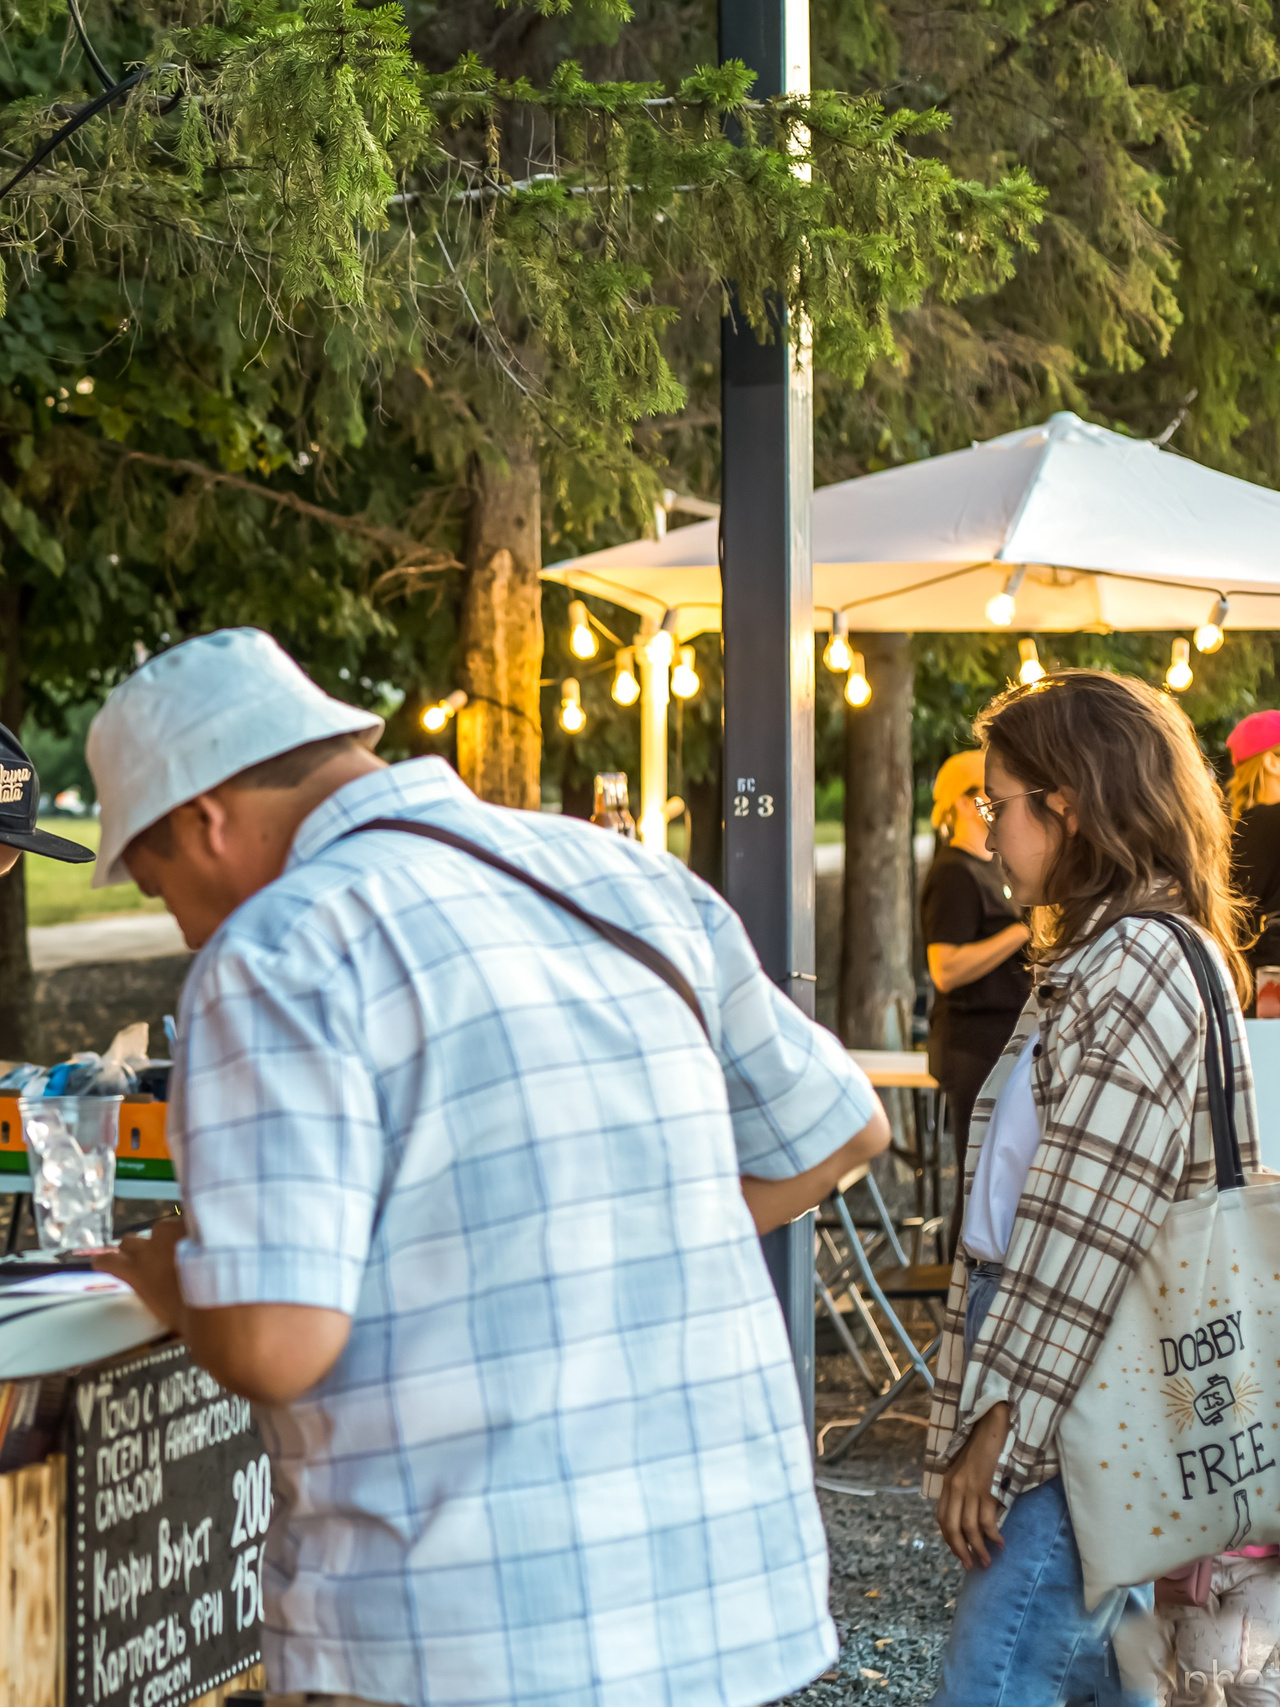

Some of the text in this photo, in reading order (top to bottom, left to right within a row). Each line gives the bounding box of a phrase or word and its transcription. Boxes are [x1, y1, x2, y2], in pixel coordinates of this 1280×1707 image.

[734, 794, 775, 818] 23
[1159, 1310, 1245, 1377] DOBBY
[1202, 1391, 1225, 1412] IS
[1176, 1422, 1276, 1500] FREE
